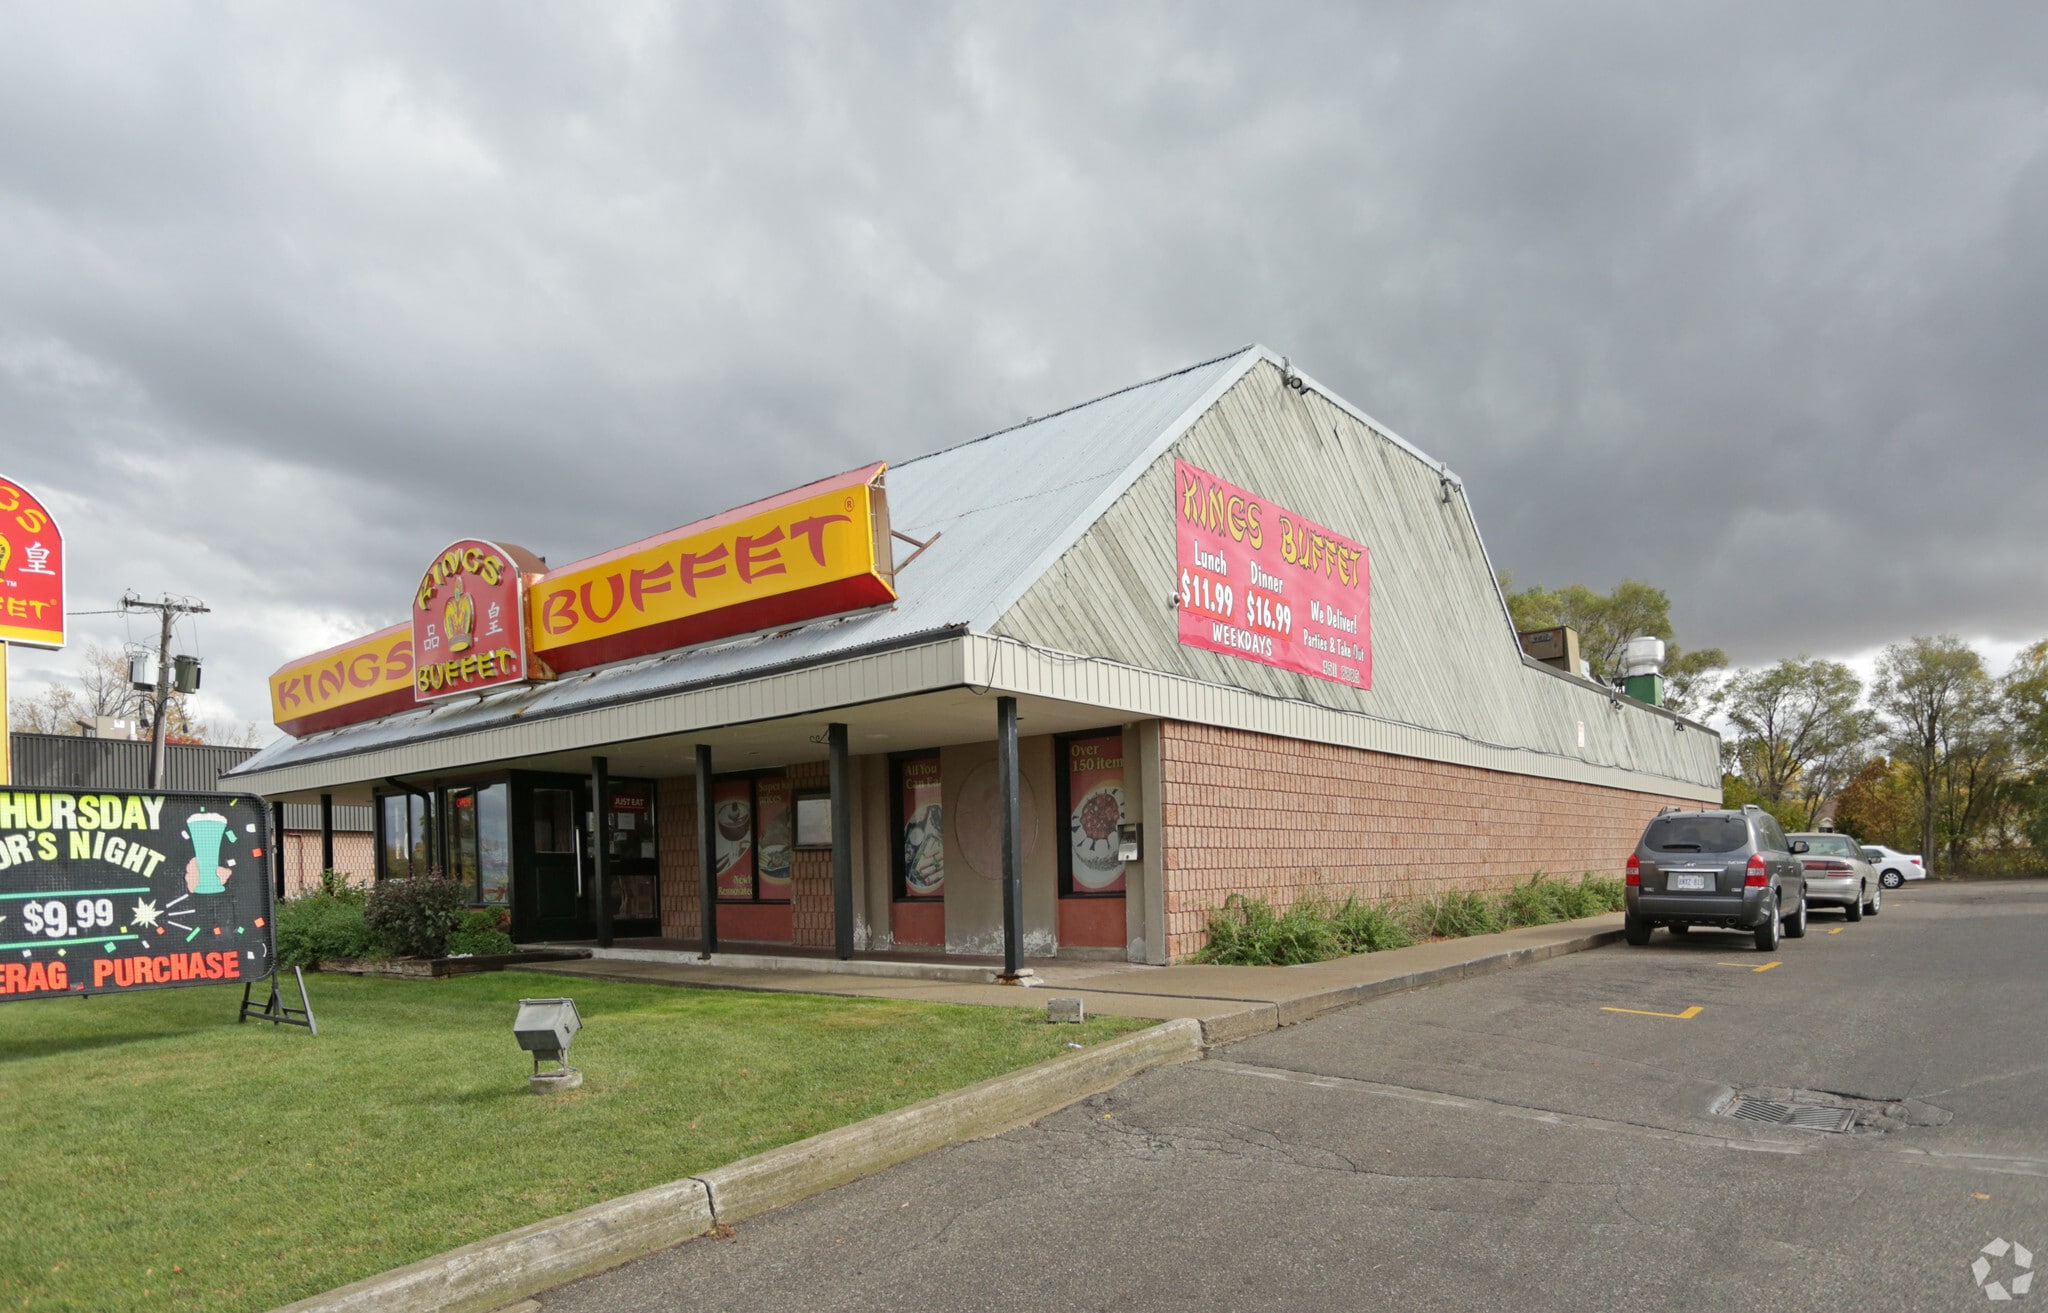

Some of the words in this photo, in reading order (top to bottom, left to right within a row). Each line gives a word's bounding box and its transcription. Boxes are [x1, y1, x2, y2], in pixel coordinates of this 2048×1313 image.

[1181, 469, 1263, 550] KINGS
[1279, 515, 1362, 589] BUFFET
[18, 541, 56, 576] 皇
[541, 514, 853, 636] BUFFET
[1193, 539, 1227, 576] Lunch
[417, 548, 505, 611] KINGS
[1181, 568, 1233, 618] $11.99
[1250, 560, 1284, 594] Dinner
[0, 596, 51, 620] ET
[423, 623, 440, 651] 品
[485, 601, 504, 636] 皇
[1246, 590, 1292, 635] $16.99
[1310, 599, 1325, 624] We
[1326, 604, 1357, 635] Deliver!
[1212, 622, 1273, 657] WEEKDAYS
[1303, 628, 1328, 651] Parties
[1329, 636, 1336, 654] &
[1336, 638, 1351, 658] Take
[1353, 643, 1364, 662] Out
[278, 640, 414, 712] KINGS
[417, 648, 518, 692] BUFFET
[1071, 744, 1099, 757] Over
[1073, 758, 1095, 772] 150
[905, 764, 918, 776] All
[919, 763, 937, 775] You
[905, 778, 925, 790] Can
[0, 792, 165, 830] HURSDAY
[615, 797, 630, 806] JUST
[631, 798, 645, 807] EAT
[70, 830, 166, 878] NIGHT
[23, 898, 114, 938] $9.99
[93, 950, 242, 988] PURCHASE
